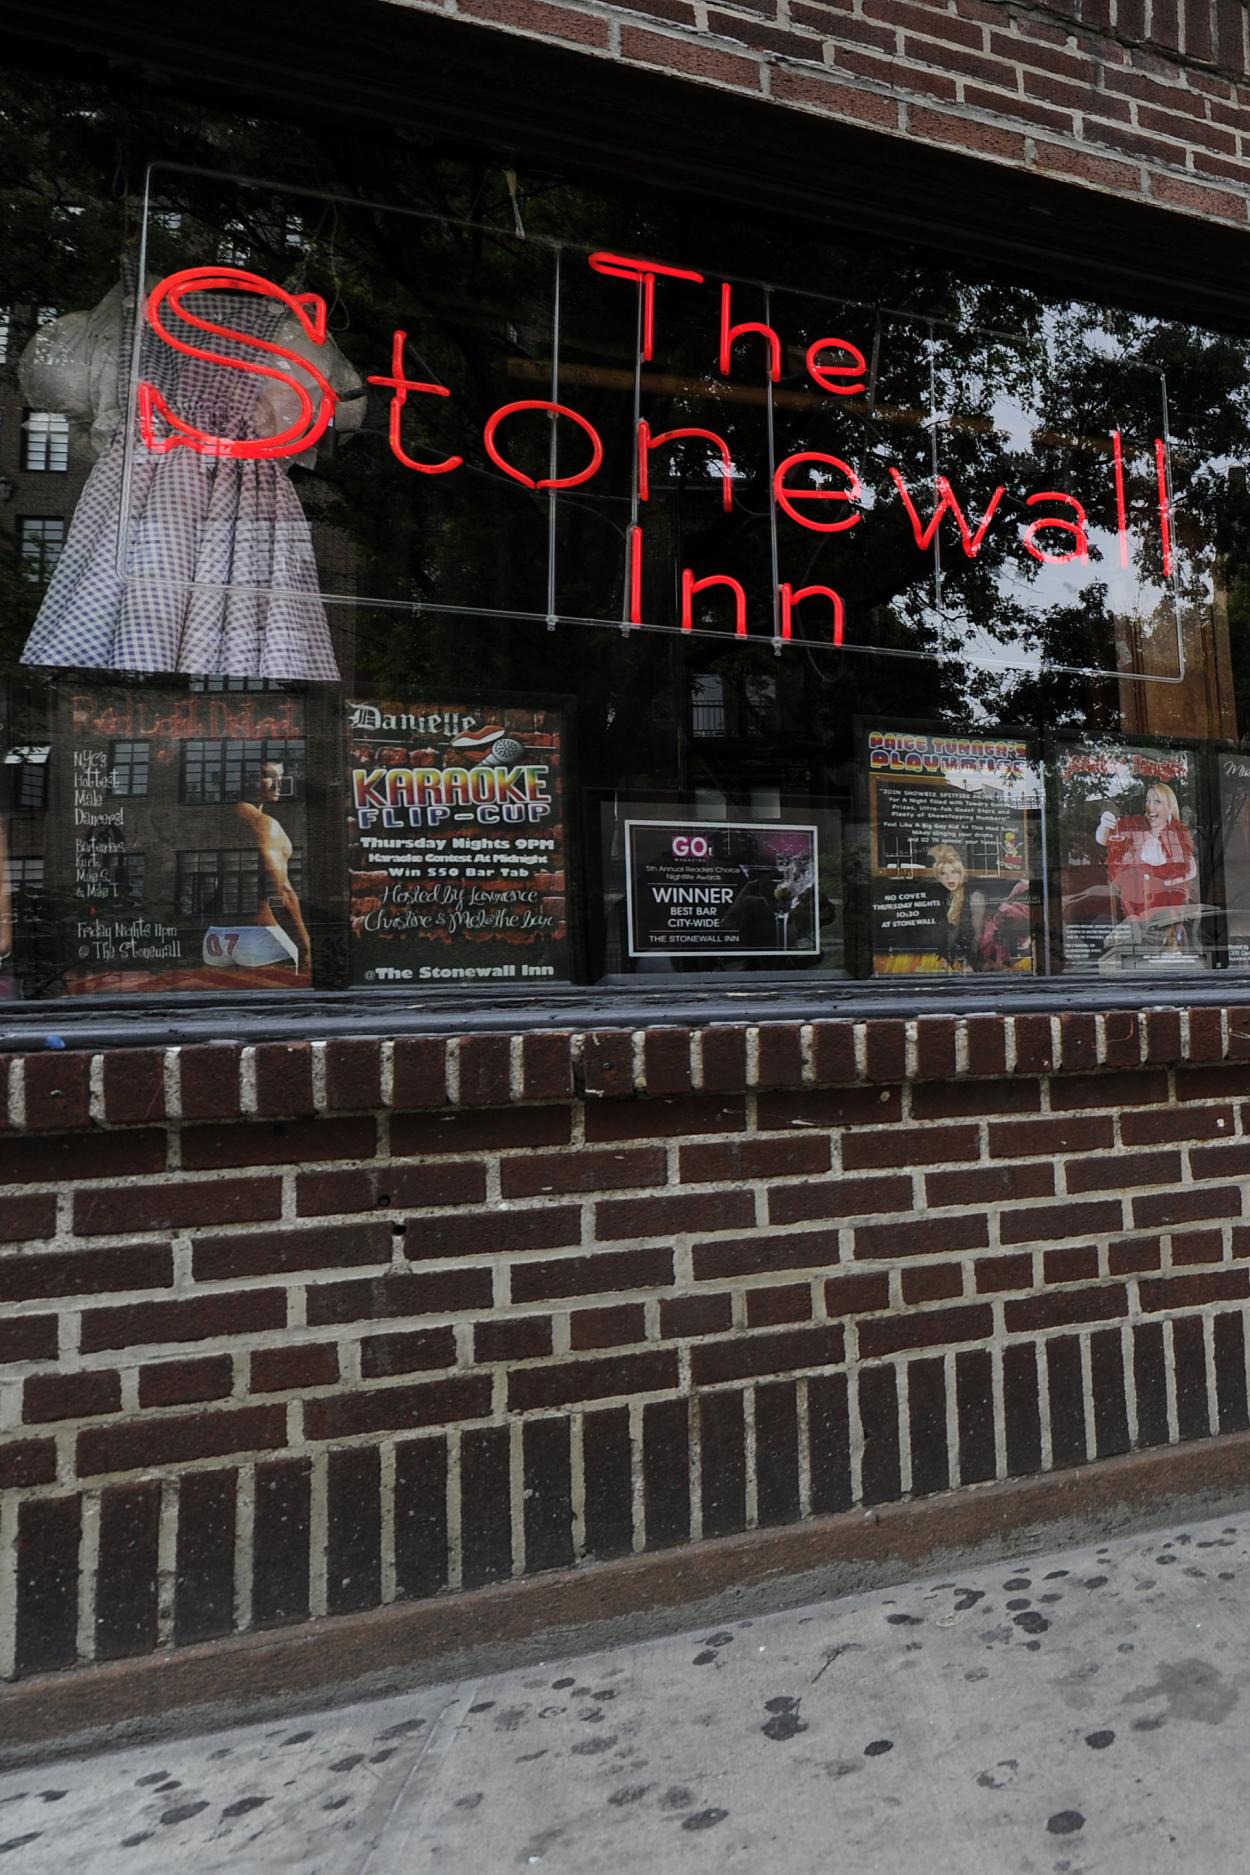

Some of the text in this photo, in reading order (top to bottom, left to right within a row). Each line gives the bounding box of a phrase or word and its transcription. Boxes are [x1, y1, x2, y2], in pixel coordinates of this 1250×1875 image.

[588, 251, 867, 395] The
[137, 265, 1173, 578] Stonewall
[629, 525, 845, 648] Inn
[74, 769, 119, 787] Hottest
[353, 765, 551, 809] KARAOKE
[75, 790, 102, 807] Male
[358, 804, 550, 829] FLIP-CUP
[360, 837, 554, 850] Thursday Nights 9PM
[493, 854, 548, 865] Midnight
[388, 868, 529, 877] Win $50 Bar Tab
[381, 884, 439, 905] Hosted
[653, 887, 733, 904] WINNER
[884, 892, 927, 901] NO COVER
[670, 907, 717, 916] BEST BAR
[872, 900, 941, 911] THURSDAY NIGHTS
[896, 910, 919, 918] 10:30
[668, 918, 720, 928] CITY-WIDE
[881, 918, 936, 928] AT STONEWALL
[78, 922, 112, 946] Friday
[115, 917, 150, 938] Nights
[649, 935, 667, 943] THE
[669, 935, 722, 943] STONEWALL
[78, 939, 181, 960] @ The Stonewall
[419, 965, 515, 978] Stonewall
[522, 964, 554, 977] Inn
